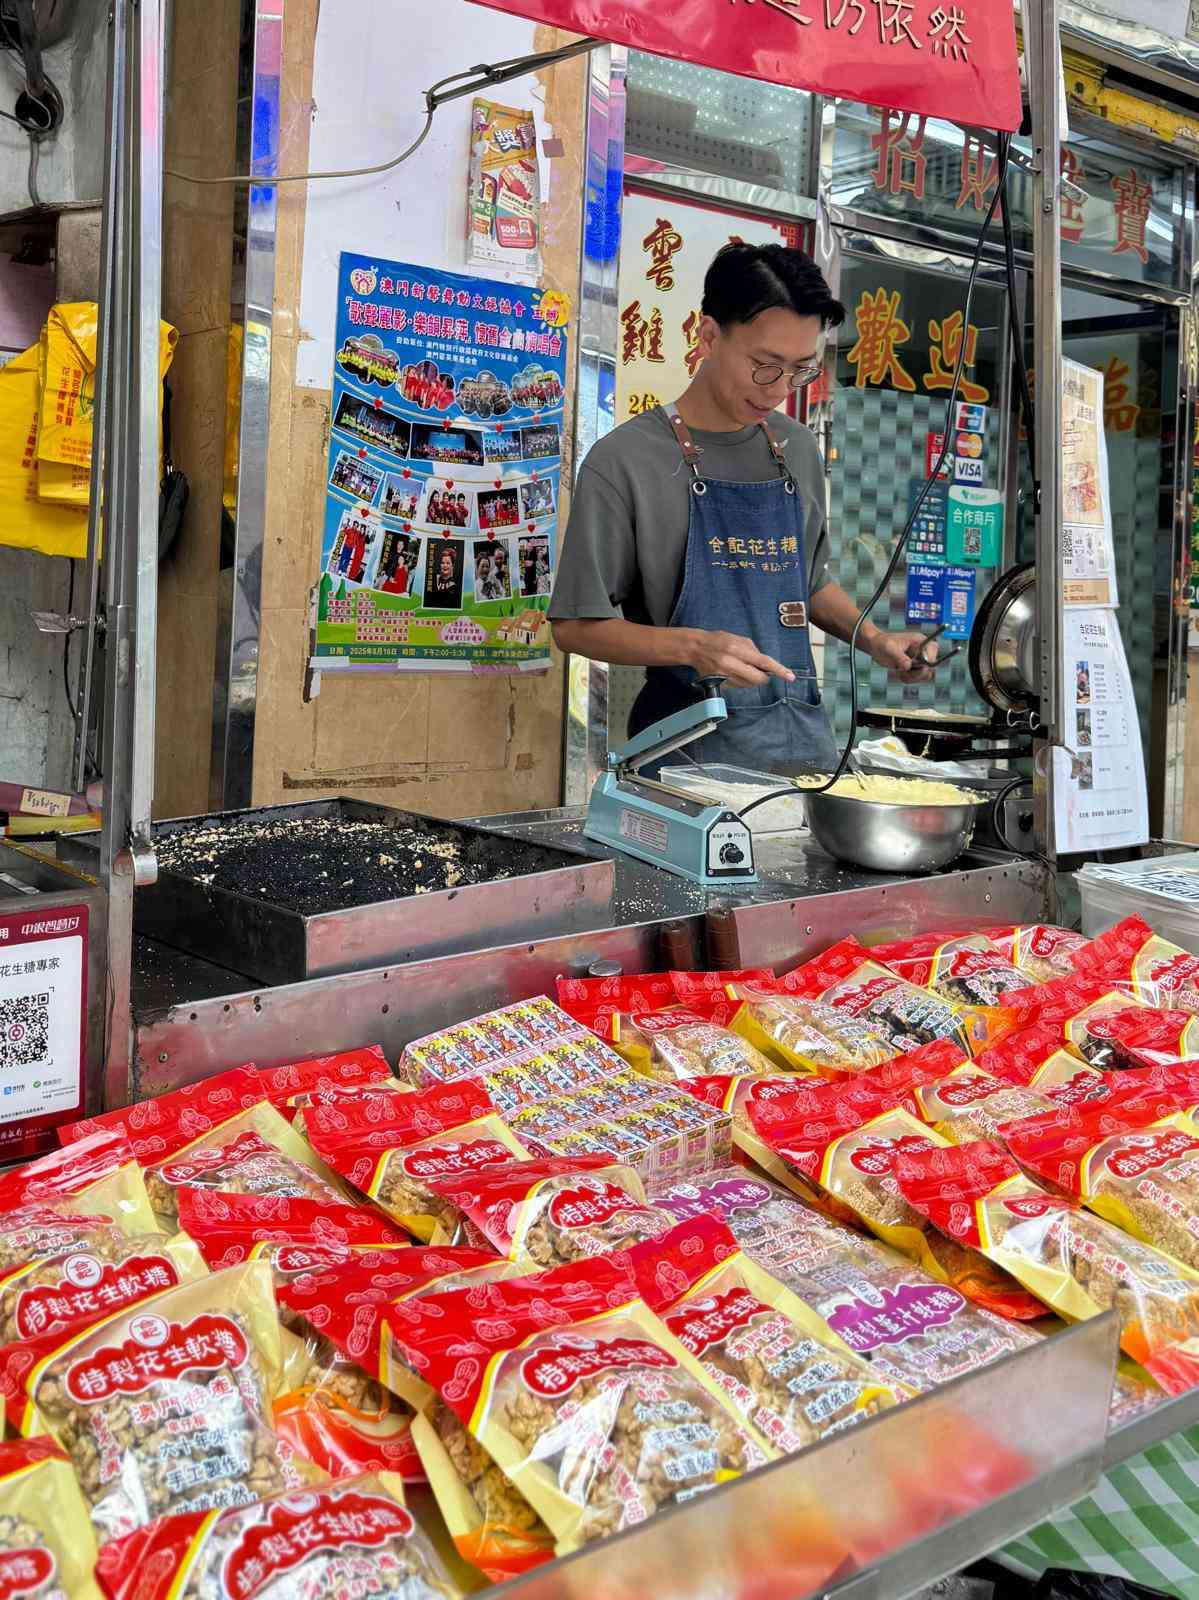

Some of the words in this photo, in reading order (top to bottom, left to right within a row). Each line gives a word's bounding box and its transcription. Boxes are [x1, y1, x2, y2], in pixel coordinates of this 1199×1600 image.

[958, 462, 982, 477] VISA
[952, 506, 993, 524] 合作商戶
[0, 957, 60, 978] 花生糖專家
[23, 1265, 171, 1332] 特製花生軟糖
[78, 1329, 238, 1397] 特製花生軟糖
[236, 1508, 400, 1592] 特製花生軟糖
